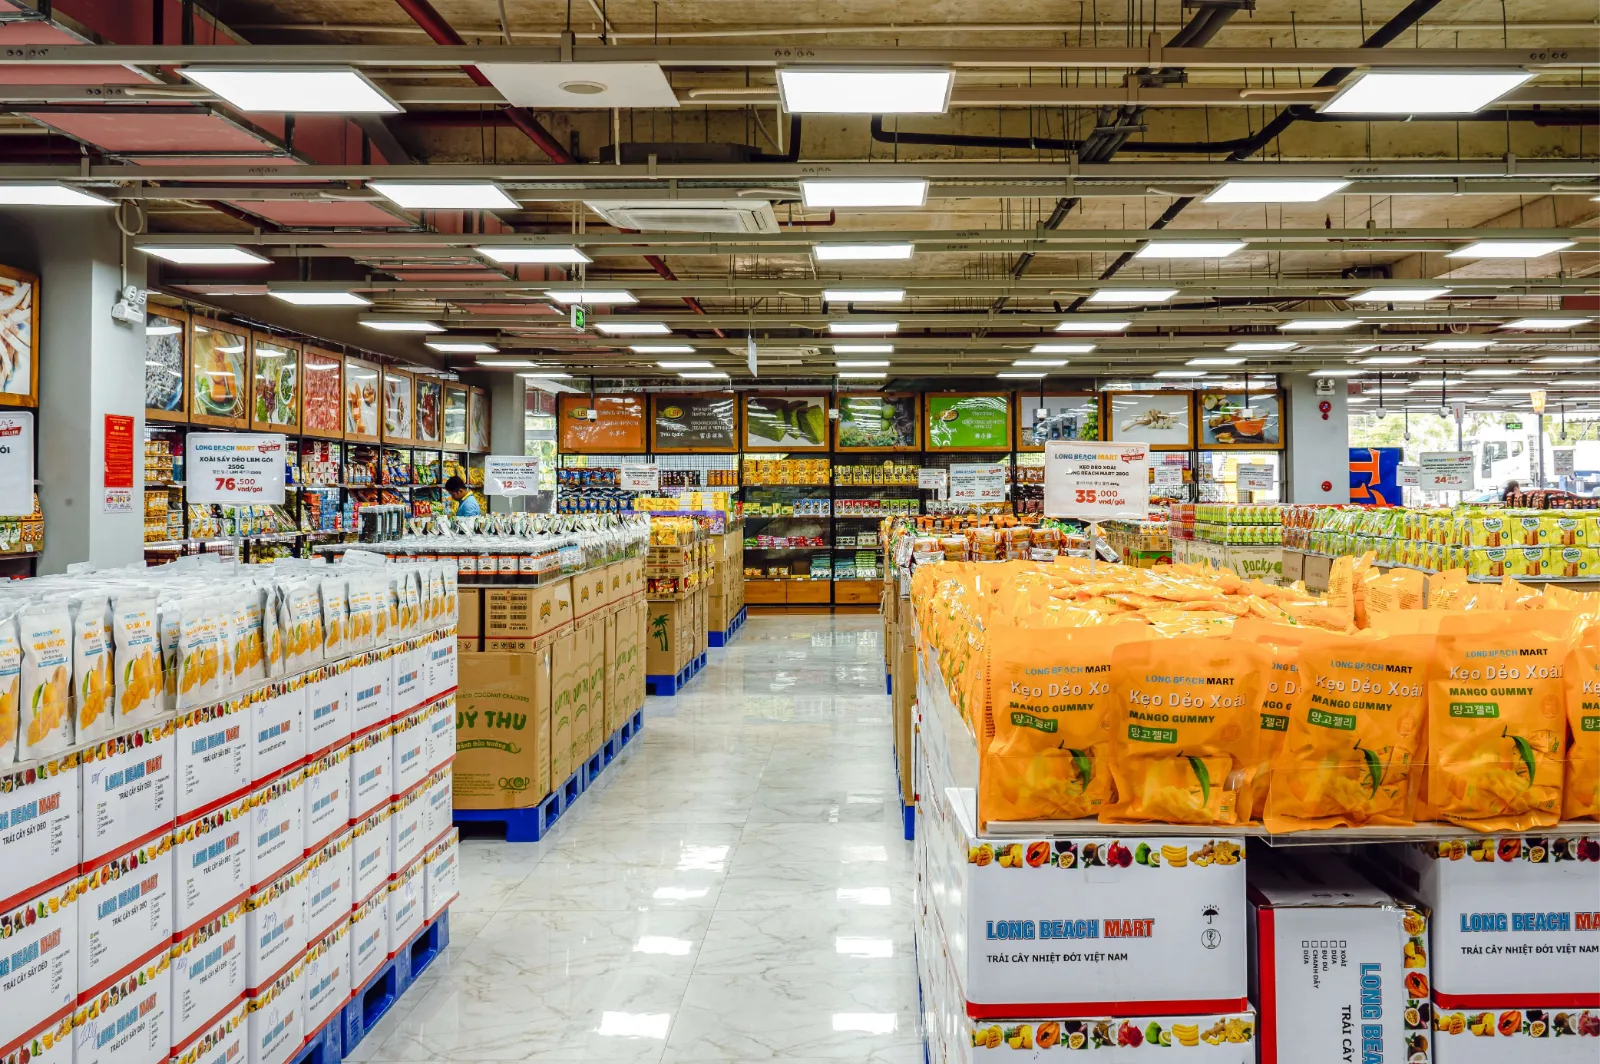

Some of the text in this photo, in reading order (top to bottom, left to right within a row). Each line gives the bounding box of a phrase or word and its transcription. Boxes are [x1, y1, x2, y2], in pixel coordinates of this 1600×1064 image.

[1073, 453, 1097, 461] BEACH
[215, 477, 236, 491] 76
[1075, 489, 1097, 504] 35
[1466, 648, 1549, 658] LONG BEACH MART
[1025, 667, 1050, 675] LONG
[1051, 666, 1084, 674] BEACH
[1330, 659, 1413, 674] LONG BEACH MART
[1449, 663, 1564, 684] Kẹo Dẻo Xoài
[1145, 674, 1235, 686] LONG BEACH MART
[1315, 674, 1346, 695] Kẹo
[1350, 676, 1382, 694] Dẻo
[502, 693, 530, 703] CRACKERS
[1011, 680, 1042, 700] Kẹo
[1048, 680, 1083, 697] Dẻo
[1129, 689, 1162, 708] Kẹo
[1169, 691, 1205, 708] Dẻo
[1449, 687, 1534, 696] MANGO GUMMY
[1010, 701, 1094, 712] MANGO GUMMY
[1311, 694, 1393, 711] MANGO GUMMY
[1453, 704, 1495, 716] 망고젤리
[484, 710, 526, 731] THU
[1014, 714, 1054, 731] 망고젤리
[1129, 710, 1215, 724] MANGO GUMMY
[1311, 711, 1353, 729] 망고젤리
[1131, 727, 1173, 741] 망고젤리
[104, 754, 163, 793] LONG BEACH MART
[10, 791, 61, 827] BEACH MART
[98, 873, 158, 921] LONG BEACH MART
[986, 918, 1155, 940] LONG BEACH MART
[1460, 912, 1508, 933] LONG
[1511, 912, 1570, 932] BEACH
[11, 927, 62, 972] BEACH MART
[986, 953, 1009, 963] TRÁI
[1011, 952, 1030, 963] CÂY
[1032, 952, 1061, 964] NHIỆT
[1084, 951, 1106, 964] VIỆT
[1107, 953, 1128, 962] NAM
[1340, 949, 1349, 967] XOÀI
[1461, 945, 1483, 955] TRÁI
[1485, 945, 1503, 955] CÂY
[1505, 945, 1534, 956] NHIỆT
[1556, 944, 1577, 956] VIỆT
[1578, 945, 1600, 954] NAM
[3, 959, 48, 992] TRÁI CÂY SẤY DẺO
[1360, 962, 1383, 1020] LONG
[1341, 1004, 1356, 1063] TRÁI CÂY
